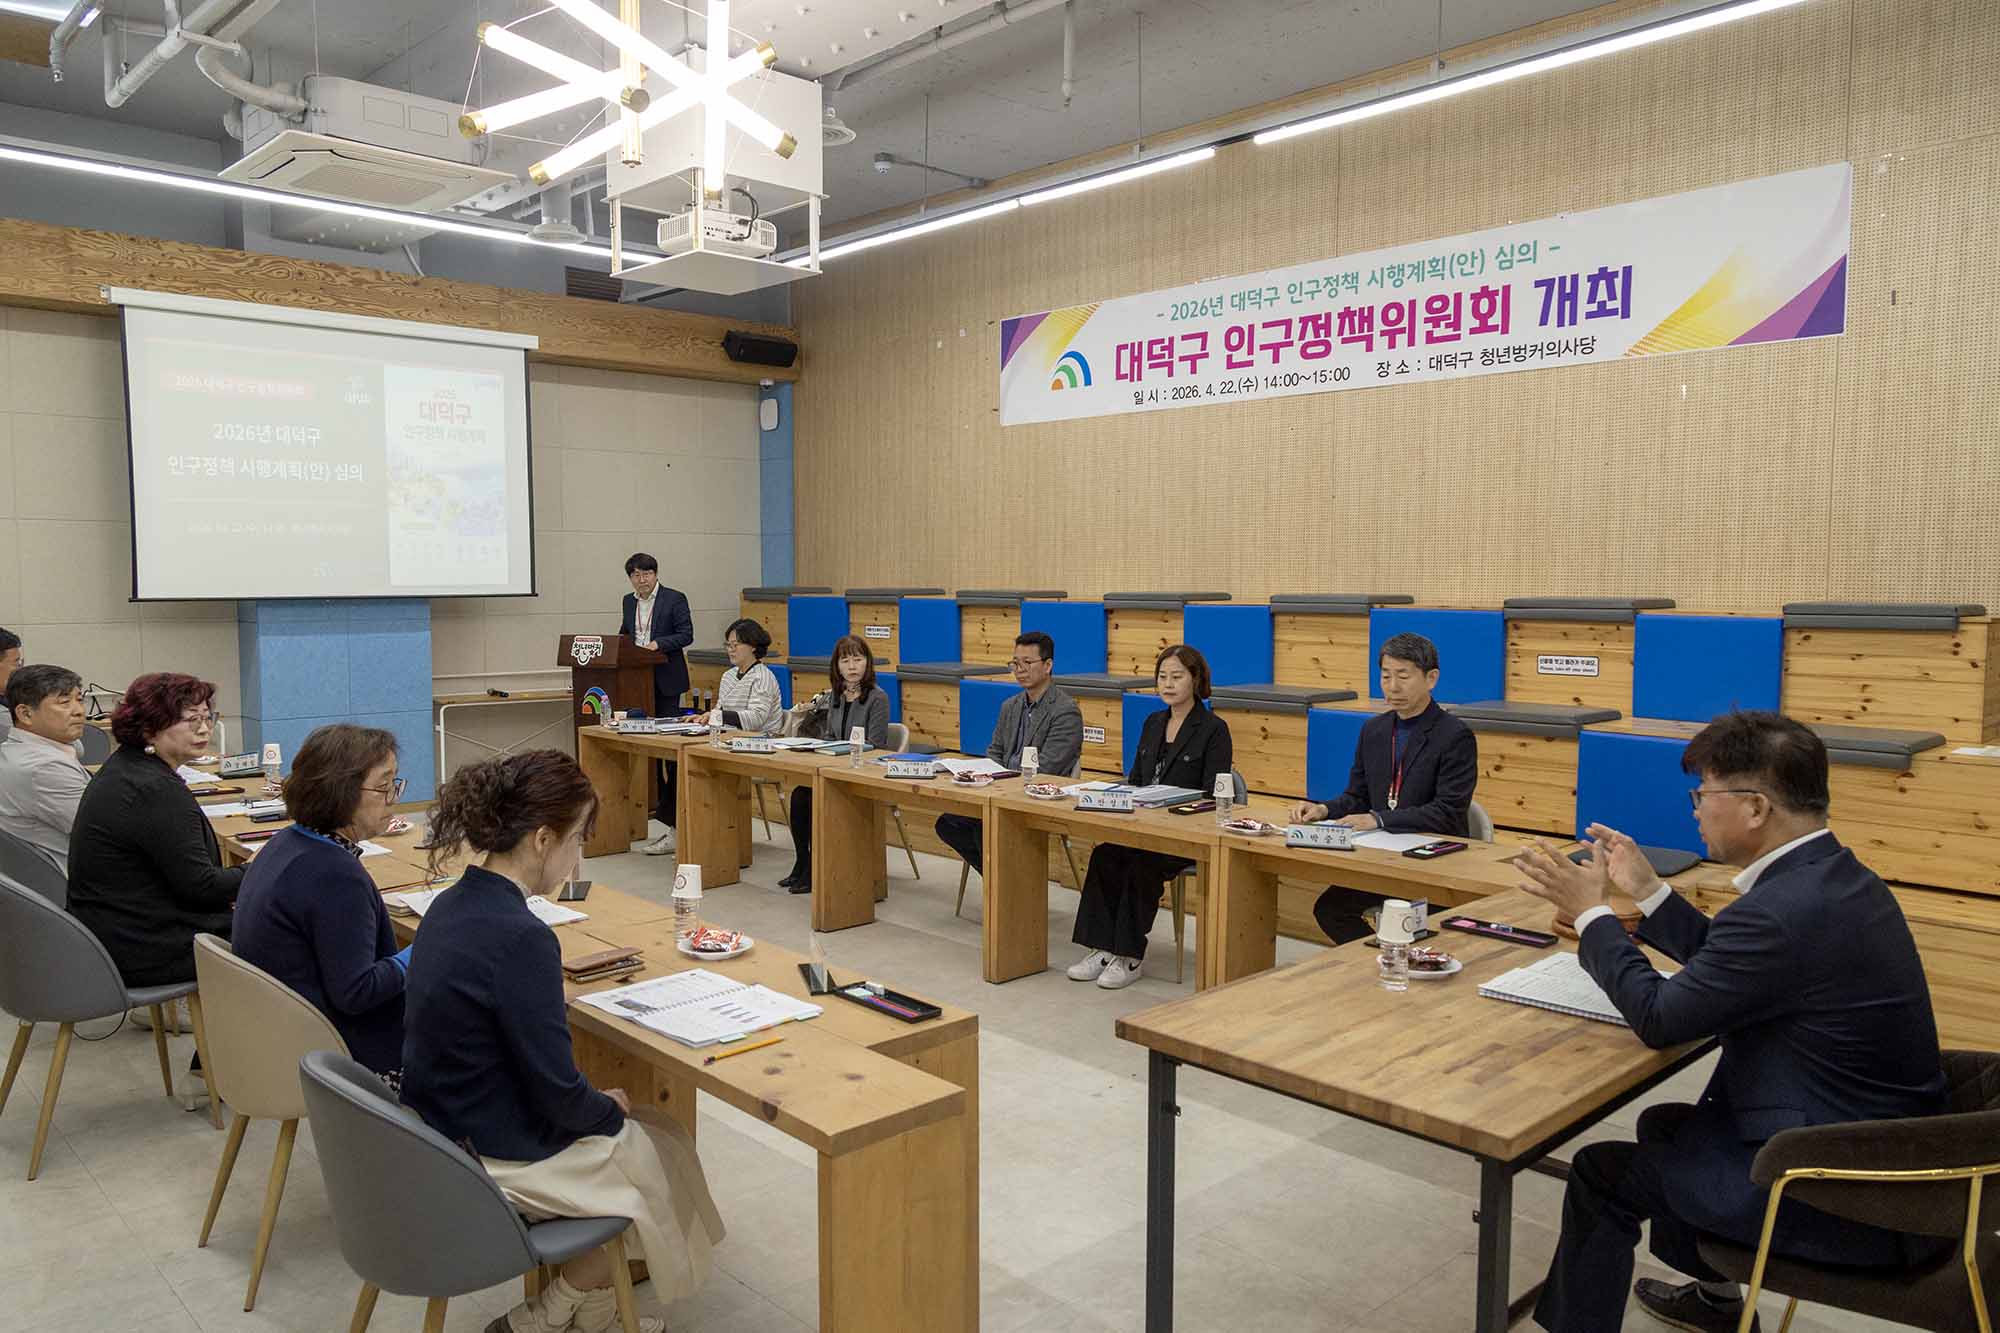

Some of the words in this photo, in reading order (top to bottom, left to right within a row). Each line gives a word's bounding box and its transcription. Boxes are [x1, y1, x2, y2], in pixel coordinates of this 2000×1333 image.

[1170, 295, 1224, 321] 2026년
[1230, 286, 1281, 312] 대덕구
[1287, 271, 1360, 304] 인구정책
[1367, 248, 1486, 289] 시행계획(안)
[1494, 239, 1538, 271] 심의
[1114, 330, 1210, 383] 대덕구
[1223, 284, 1512, 371] 인구정책위원회
[1534, 264, 1633, 328] 개최
[1428, 351, 1475, 372] 대덕구
[1479, 335, 1597, 367] 청년벙커의사당
[1171, 385, 1202, 401] 2026.
[1205, 383, 1217, 397] 4.
[1219, 375, 1260, 396] 22.(수)
[1263, 366, 1351, 390] 14:00~15:00
[213, 423, 272, 446] 2026년
[275, 424, 321, 449] 대덕구
[167, 455, 235, 478] 인구정책
[239, 458, 330, 482] 시행계획(안)
[334, 463, 364, 481] 심의
